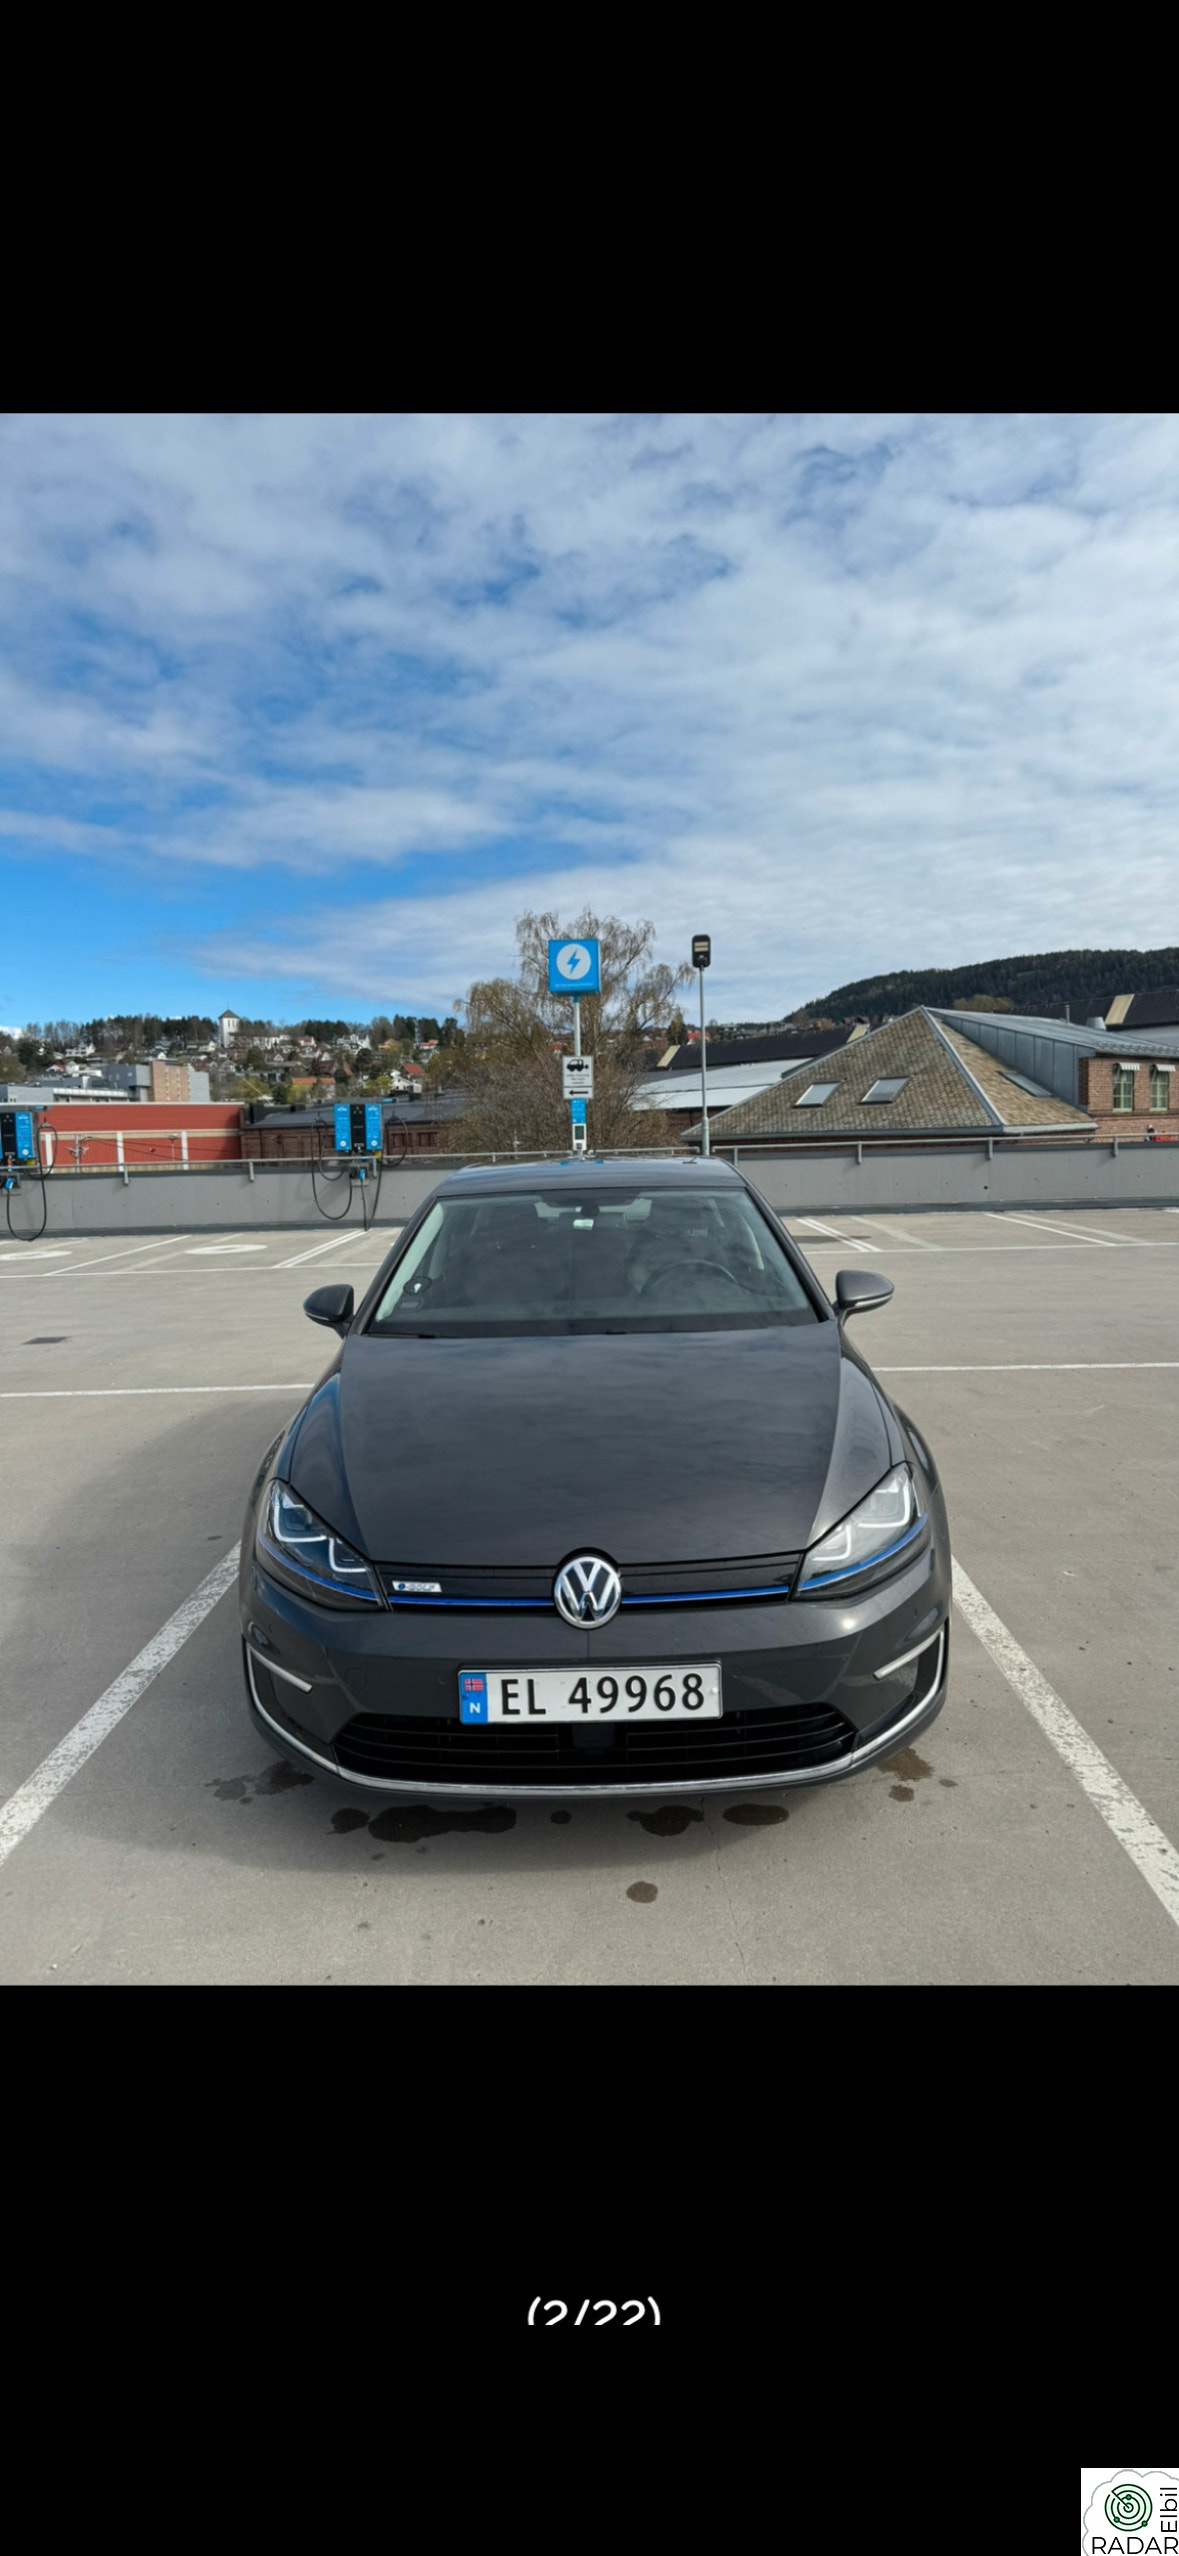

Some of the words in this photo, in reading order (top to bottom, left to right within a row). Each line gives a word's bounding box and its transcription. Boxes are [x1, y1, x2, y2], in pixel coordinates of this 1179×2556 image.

[501, 1678, 547, 1715] EL
[567, 1673, 705, 1714] 49968
[469, 1702, 481, 1714] N
